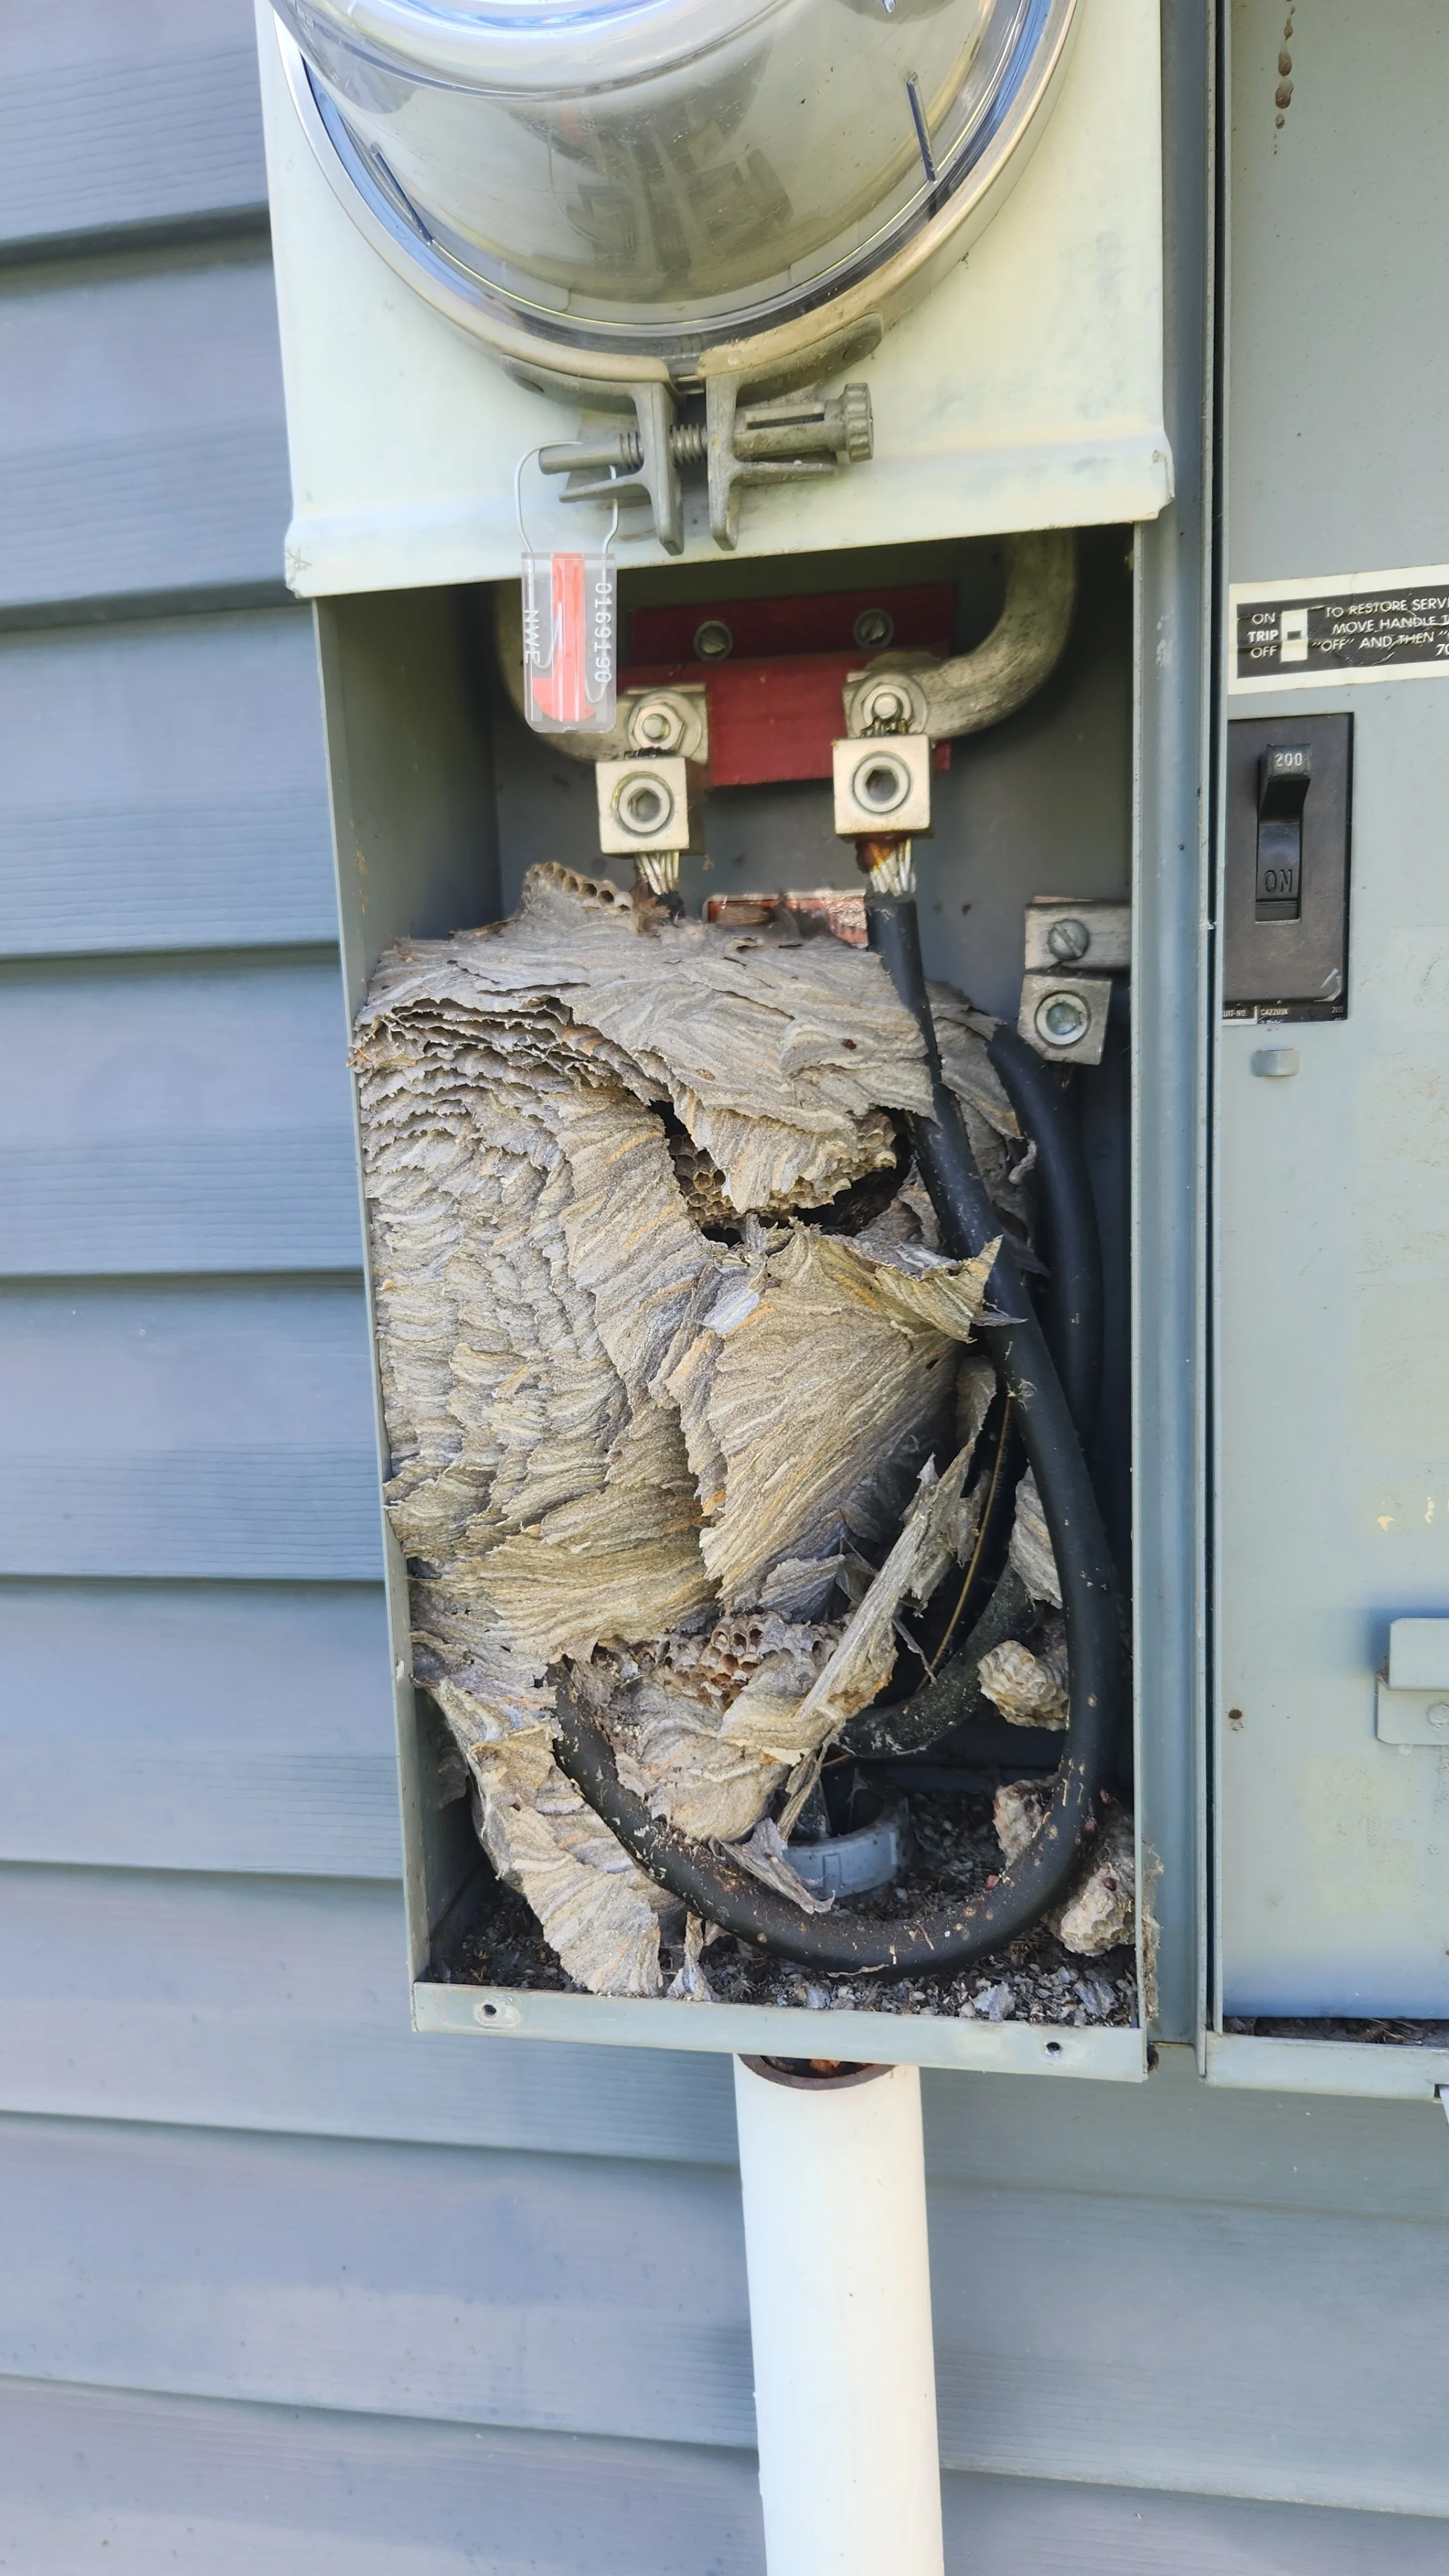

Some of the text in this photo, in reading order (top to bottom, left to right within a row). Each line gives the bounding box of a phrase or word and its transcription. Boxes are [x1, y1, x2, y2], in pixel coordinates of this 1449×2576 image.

[1251, 612, 1275, 625] ON
[1324, 607, 1344, 619] TO
[1348, 599, 1407, 616] RESTORE
[594, 582, 612, 684] 0169190
[1331, 620, 1375, 636] MOVE
[1380, 616, 1436, 629] HANDLE
[525, 610, 540, 663] NWE
[1248, 630, 1279, 643] TRIP
[1358, 636, 1393, 649] AND
[1396, 631, 1435, 645] THEN
[1250, 645, 1277, 659] OFF
[1275, 753, 1303, 767] 200
[1264, 869, 1293, 894] ON
